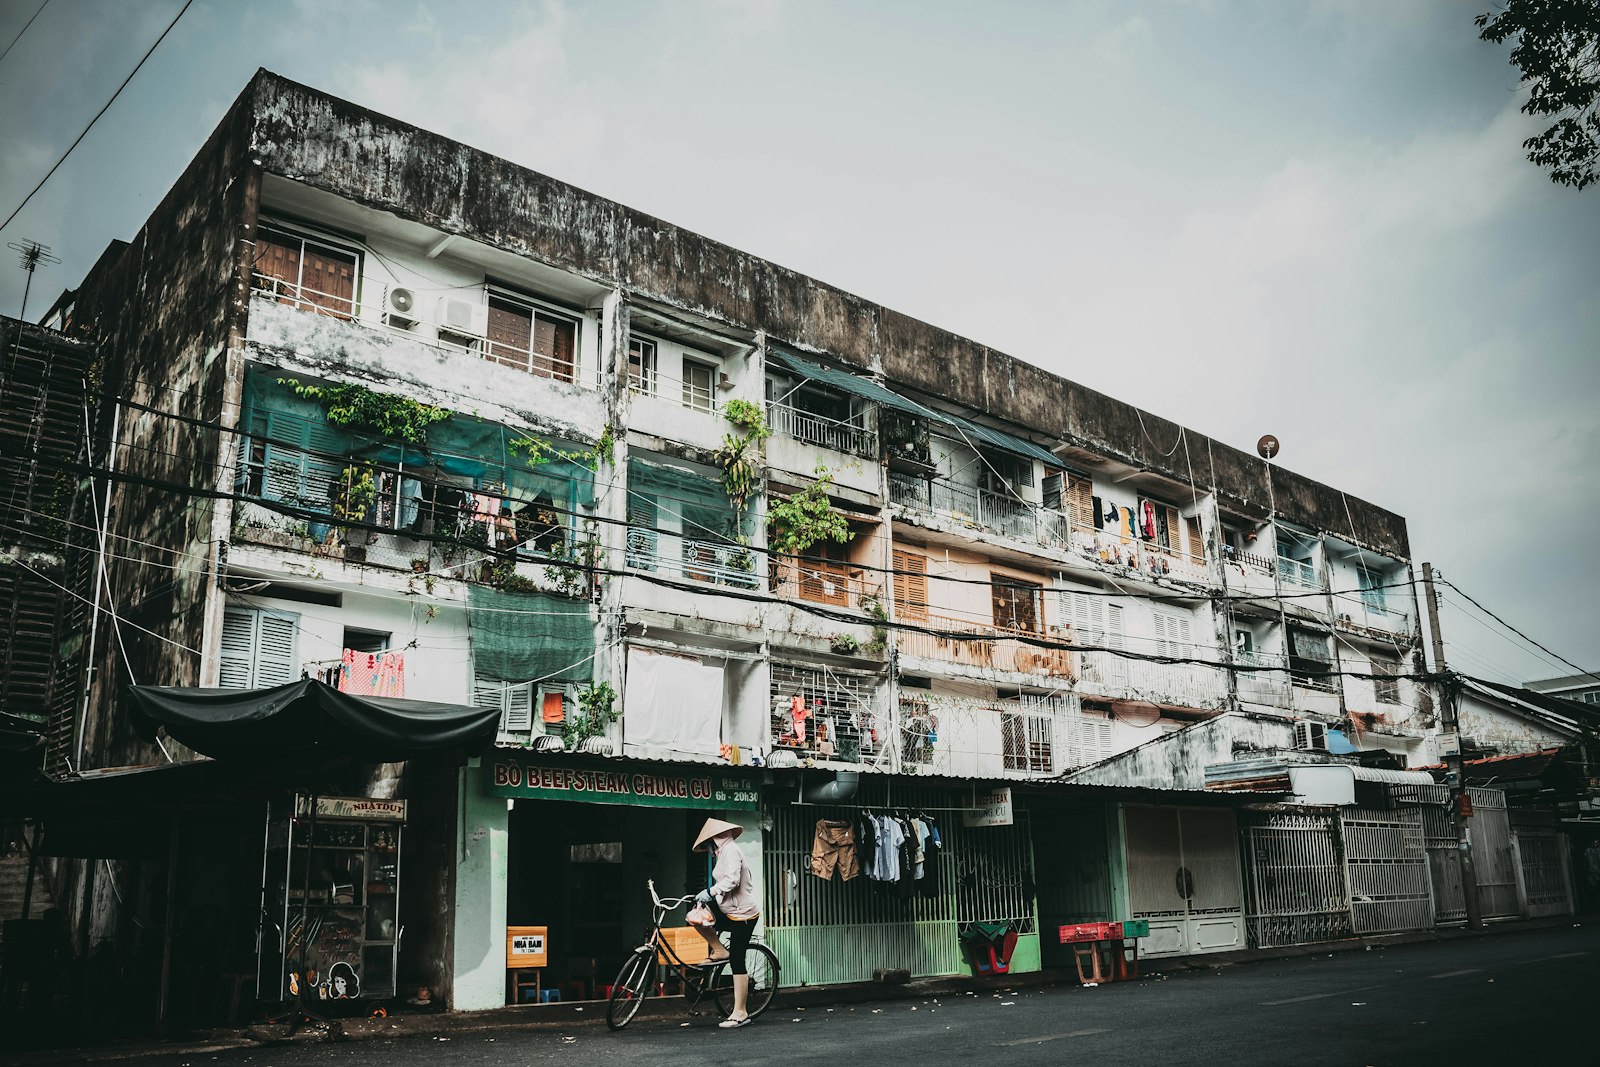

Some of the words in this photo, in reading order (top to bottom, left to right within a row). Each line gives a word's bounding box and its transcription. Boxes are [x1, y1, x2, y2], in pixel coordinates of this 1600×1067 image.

[494, 759, 522, 788] BÒ
[527, 766, 630, 795] BEEFSTEAK
[632, 773, 689, 798] CHUNG
[715, 790, 727, 801] 6h
[733, 791, 759, 802] 20h30
